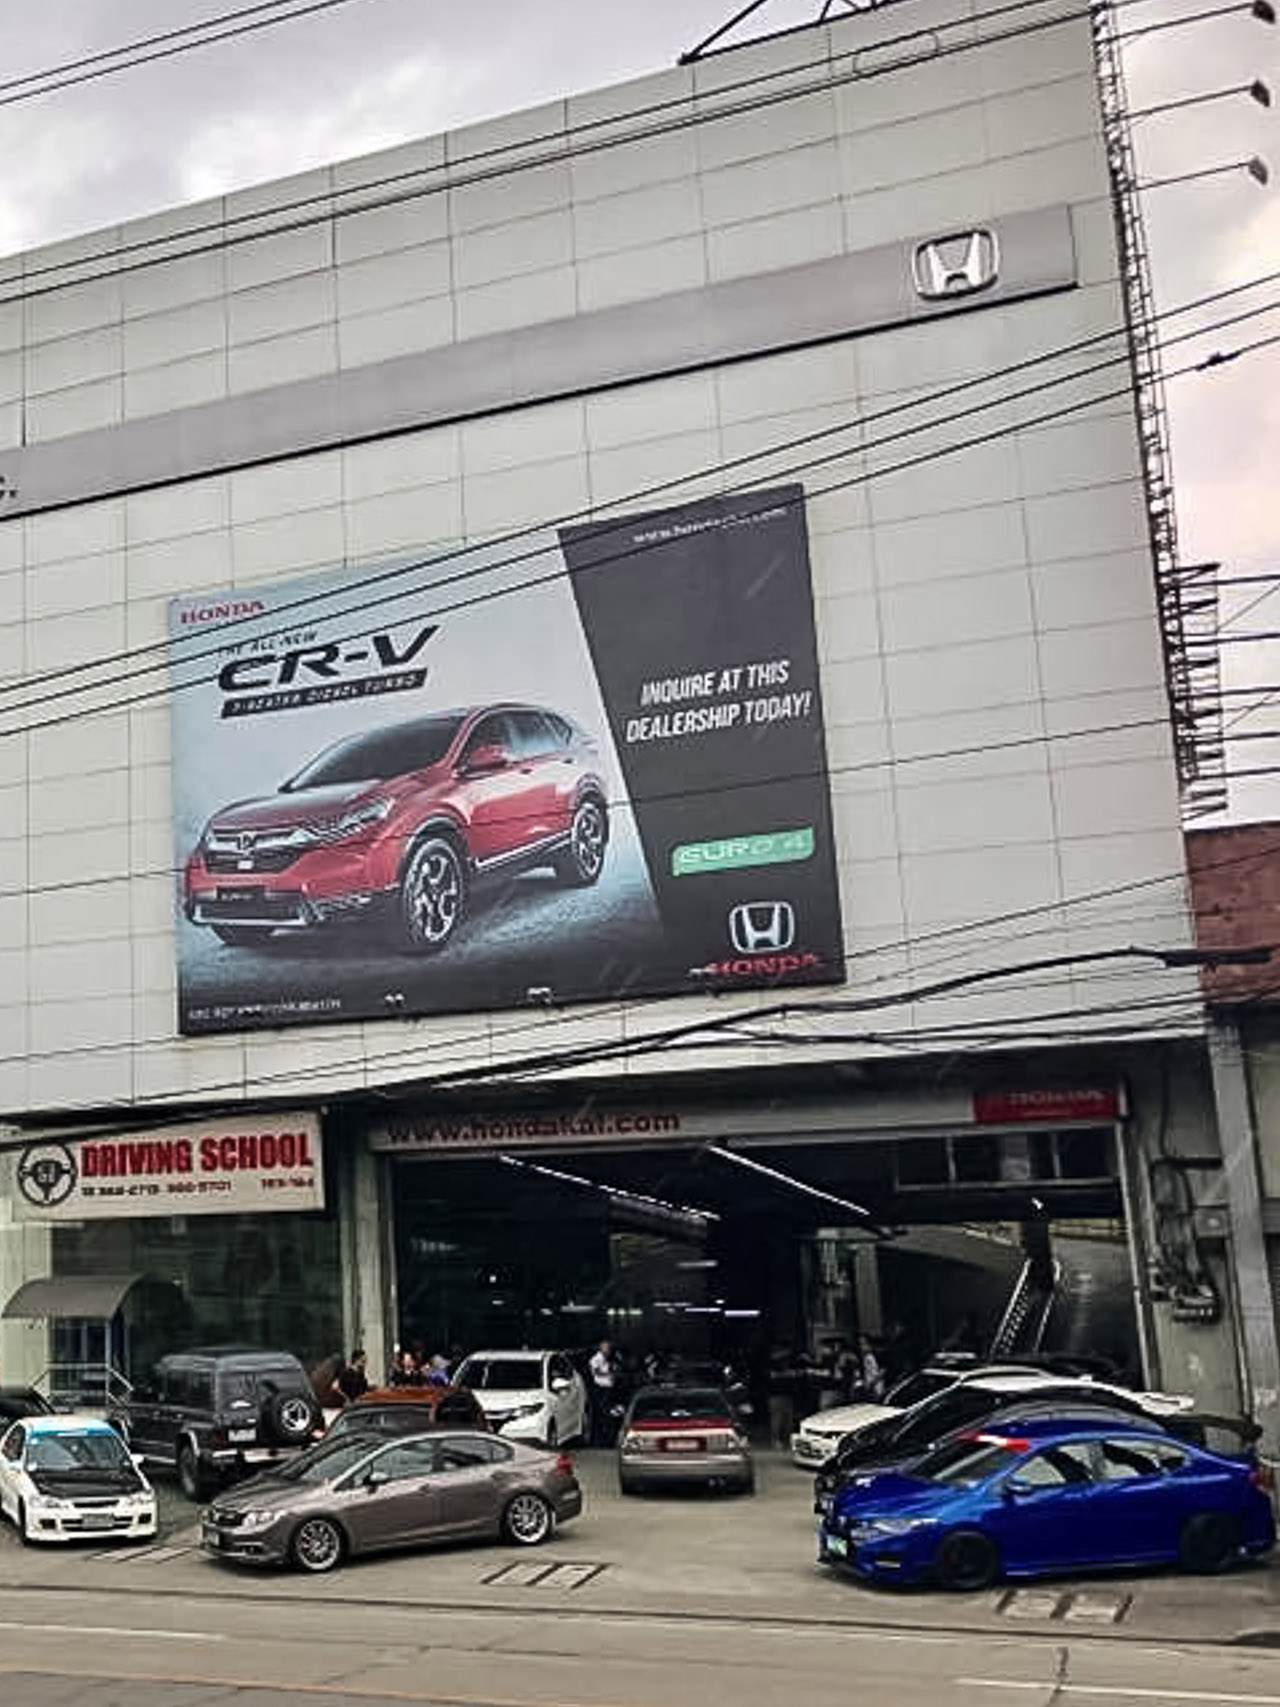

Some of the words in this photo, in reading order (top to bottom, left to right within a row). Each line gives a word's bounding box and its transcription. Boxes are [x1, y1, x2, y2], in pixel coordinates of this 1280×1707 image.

[180, 600, 266, 625] HONDA
[219, 624, 441, 692] CR-V
[640, 671, 716, 706] INQUIRE
[718, 668, 744, 693] AT
[746, 660, 791, 689] THIS
[626, 703, 741, 743] DEALERSHIP
[743, 690, 813, 724] TODAY!
[80, 1139, 193, 1177] DRIVING
[200, 1133, 314, 1172] SCHOOL
